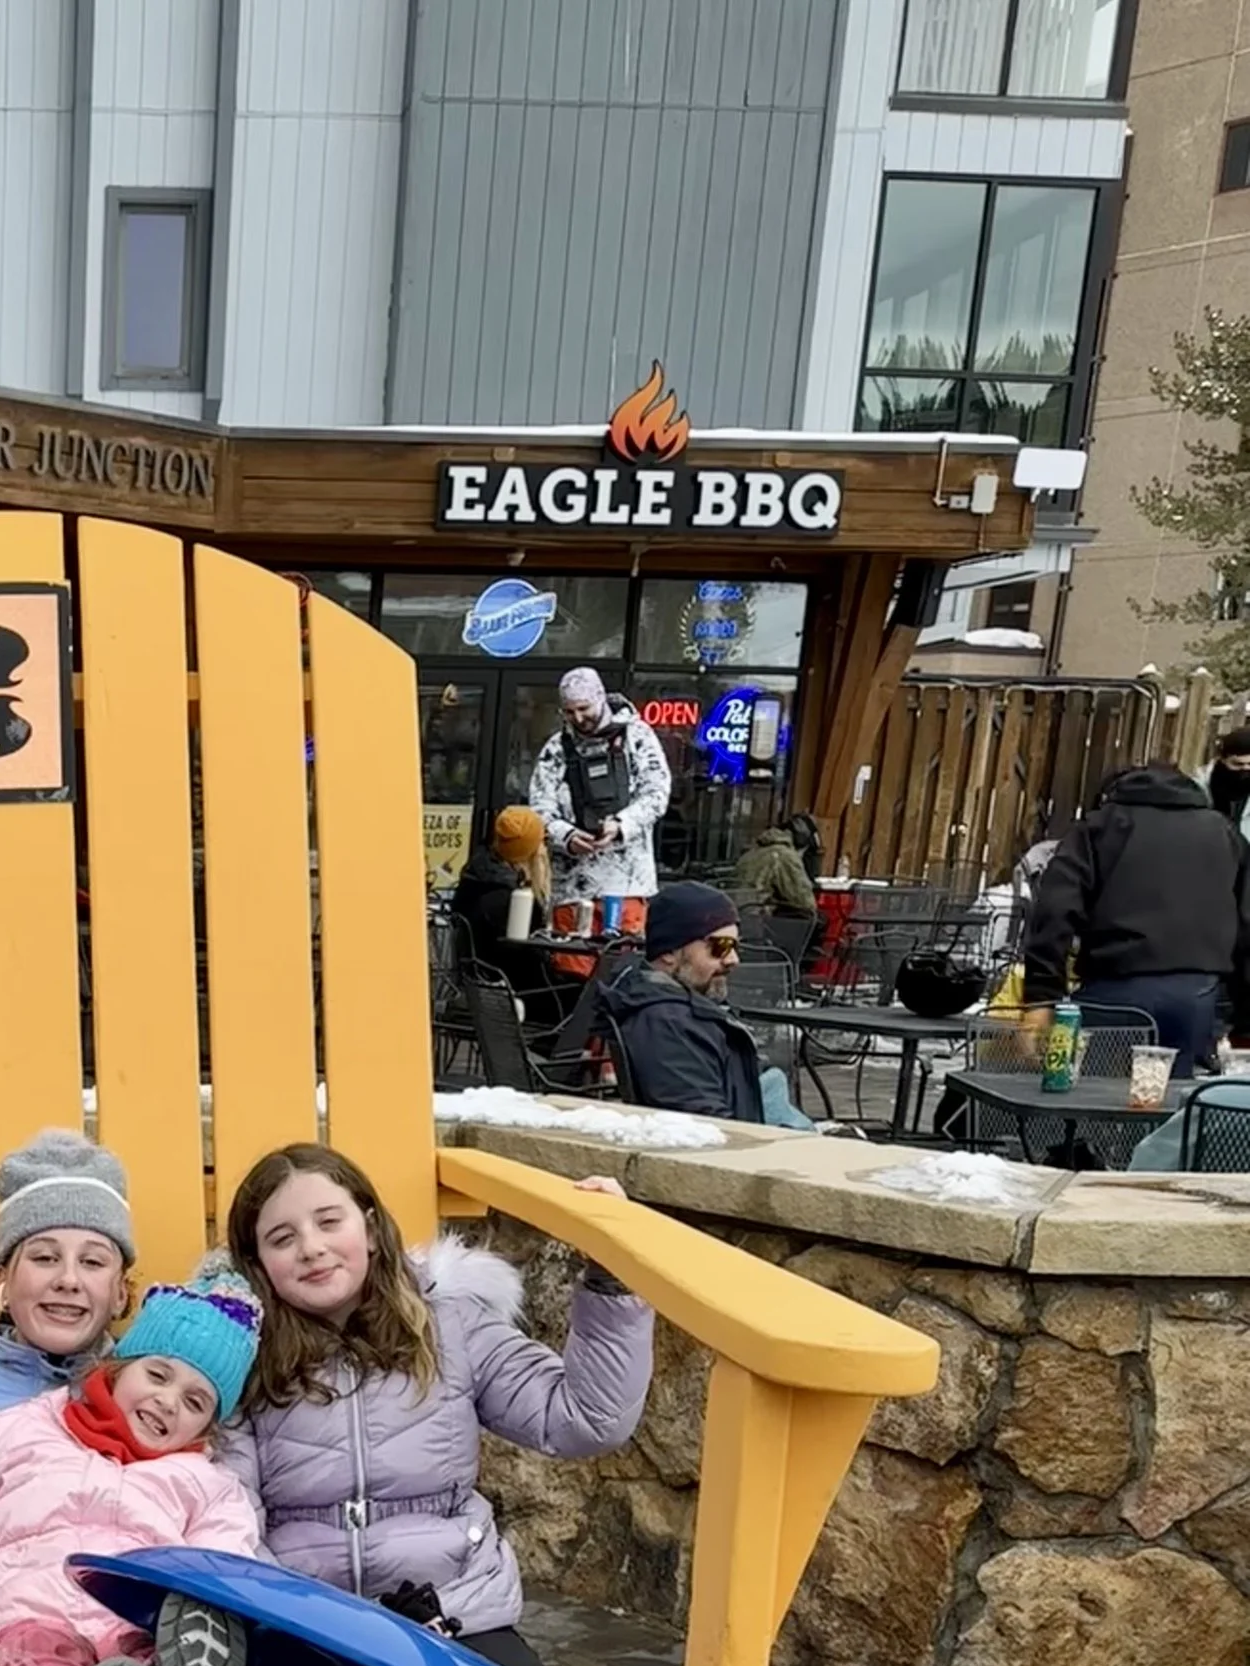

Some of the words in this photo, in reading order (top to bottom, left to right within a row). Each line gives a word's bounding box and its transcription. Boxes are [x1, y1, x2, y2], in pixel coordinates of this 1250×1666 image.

[32, 426, 214, 498] JUNCTION
[444, 465, 675, 526] EAGLE
[692, 469, 843, 531] BBQ
[643, 700, 699, 725] OPEN
[446, 814, 462, 830] OF
